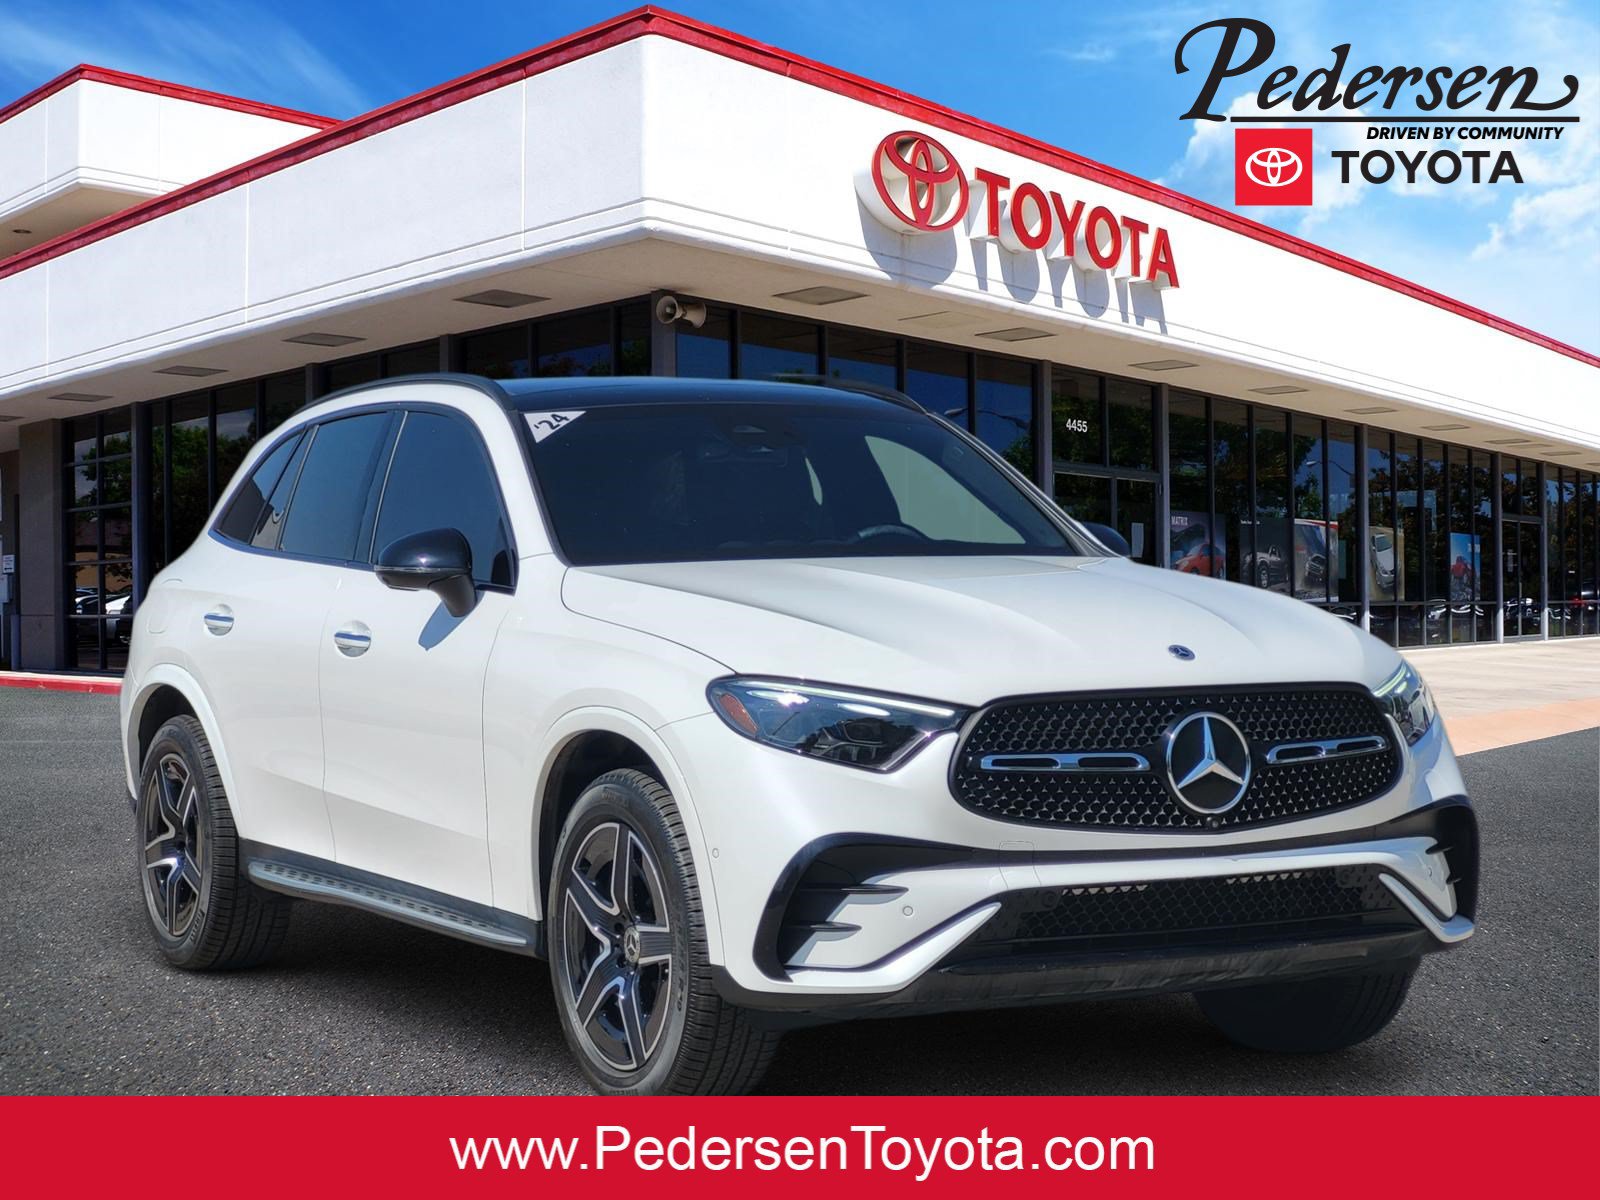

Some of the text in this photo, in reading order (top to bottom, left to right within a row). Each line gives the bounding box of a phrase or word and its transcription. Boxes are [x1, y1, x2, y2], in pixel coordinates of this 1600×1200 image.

[974, 166, 1180, 289] TOYOTA
[533, 413, 570, 430] '24
[1066, 418, 1088, 433] 4455
